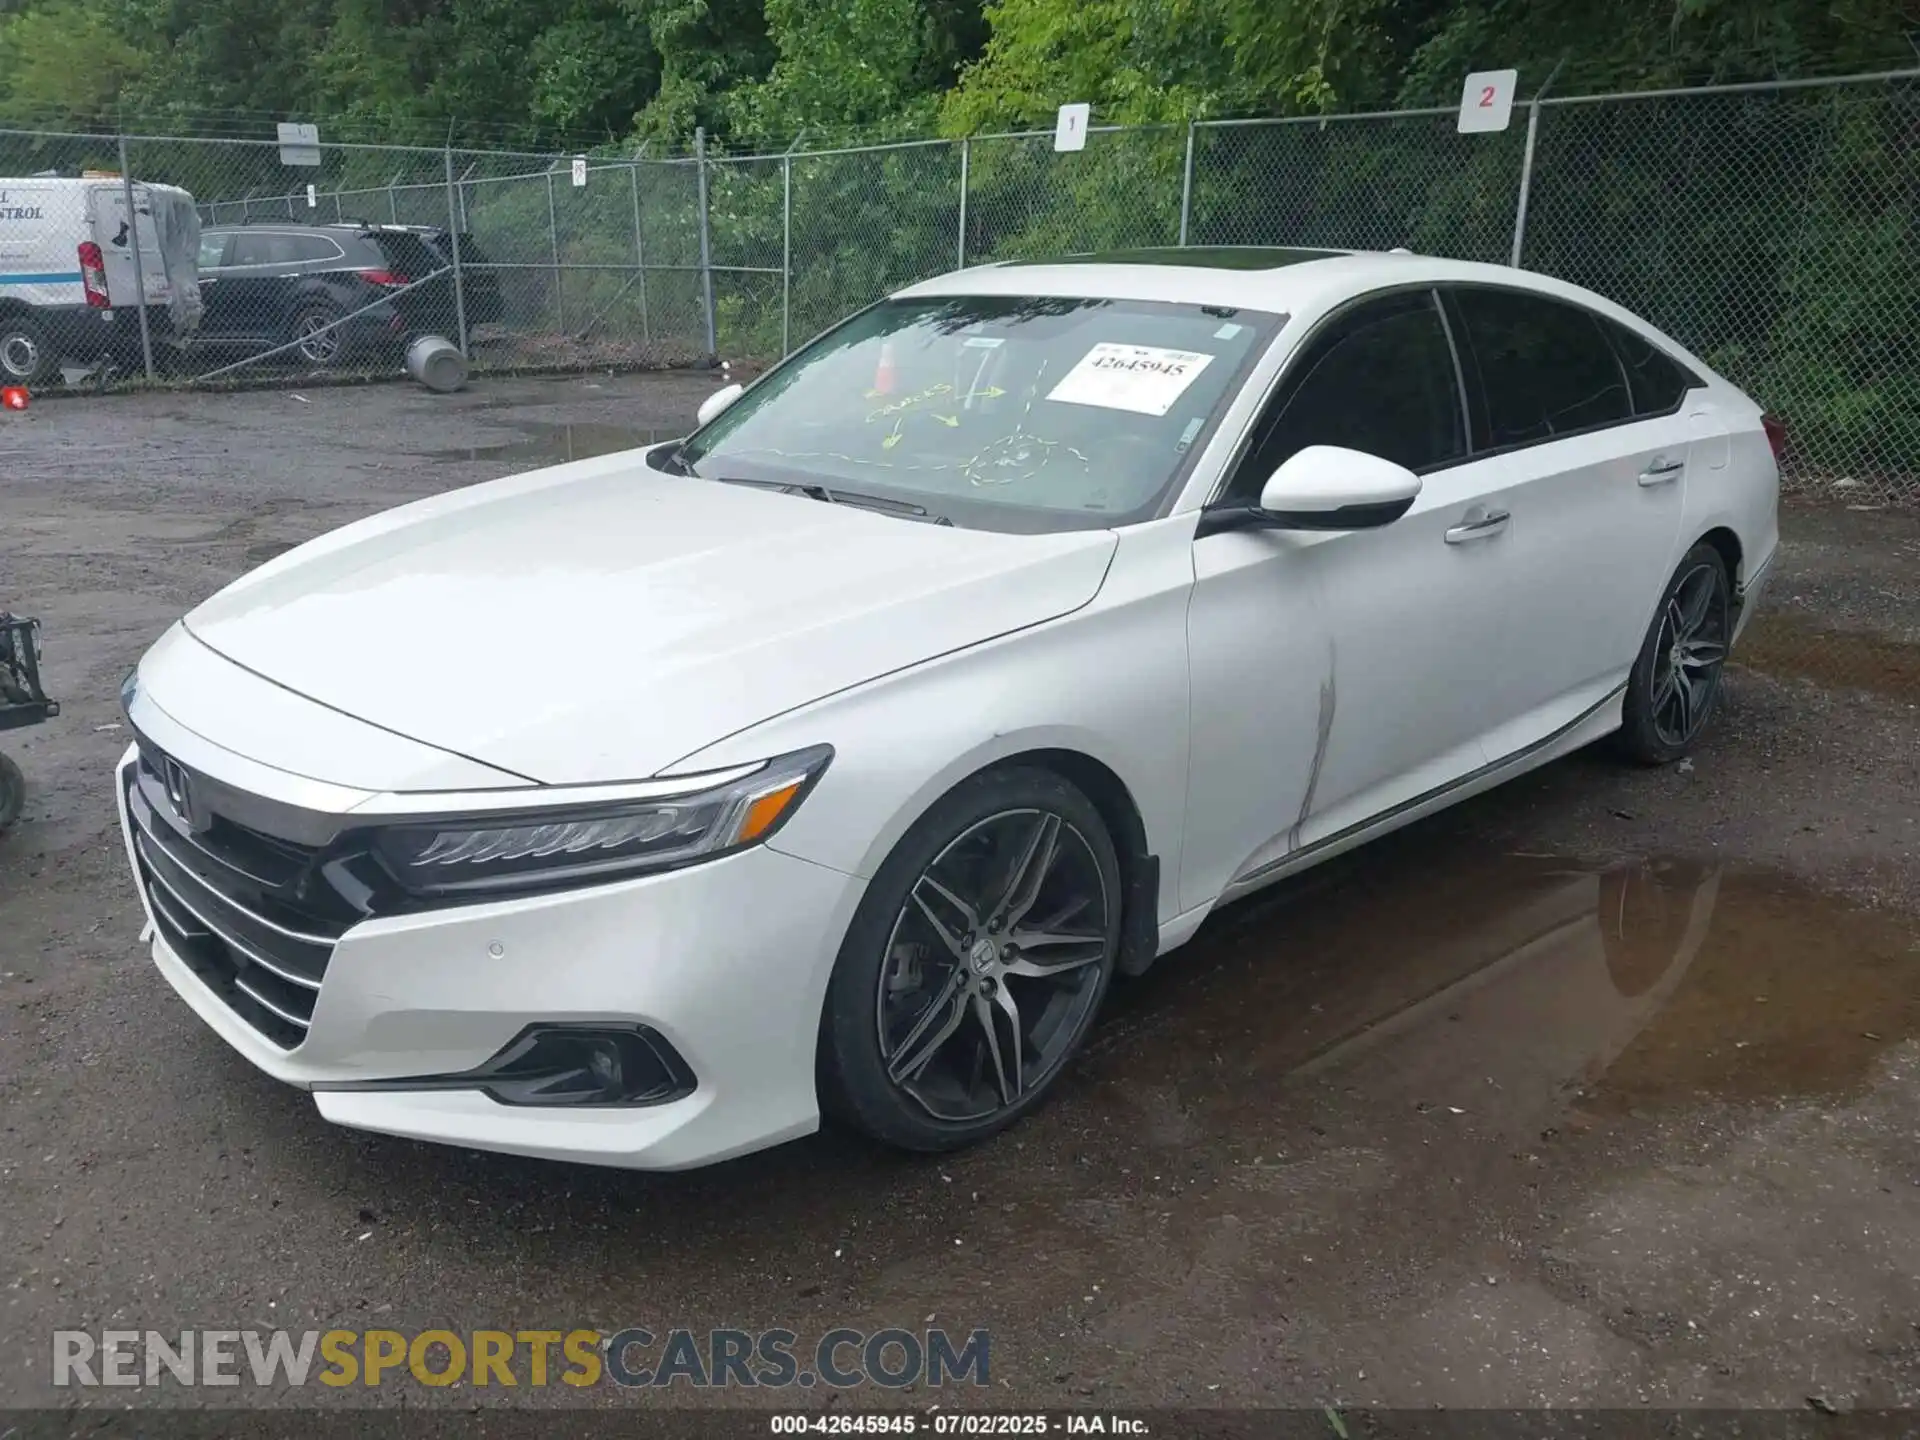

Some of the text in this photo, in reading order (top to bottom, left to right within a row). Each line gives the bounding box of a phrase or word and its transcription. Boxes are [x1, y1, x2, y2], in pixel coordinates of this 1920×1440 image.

[1479, 86, 1495, 108] 2
[1069, 115, 1075, 131] 1
[1092, 356, 1188, 376] 42645945
